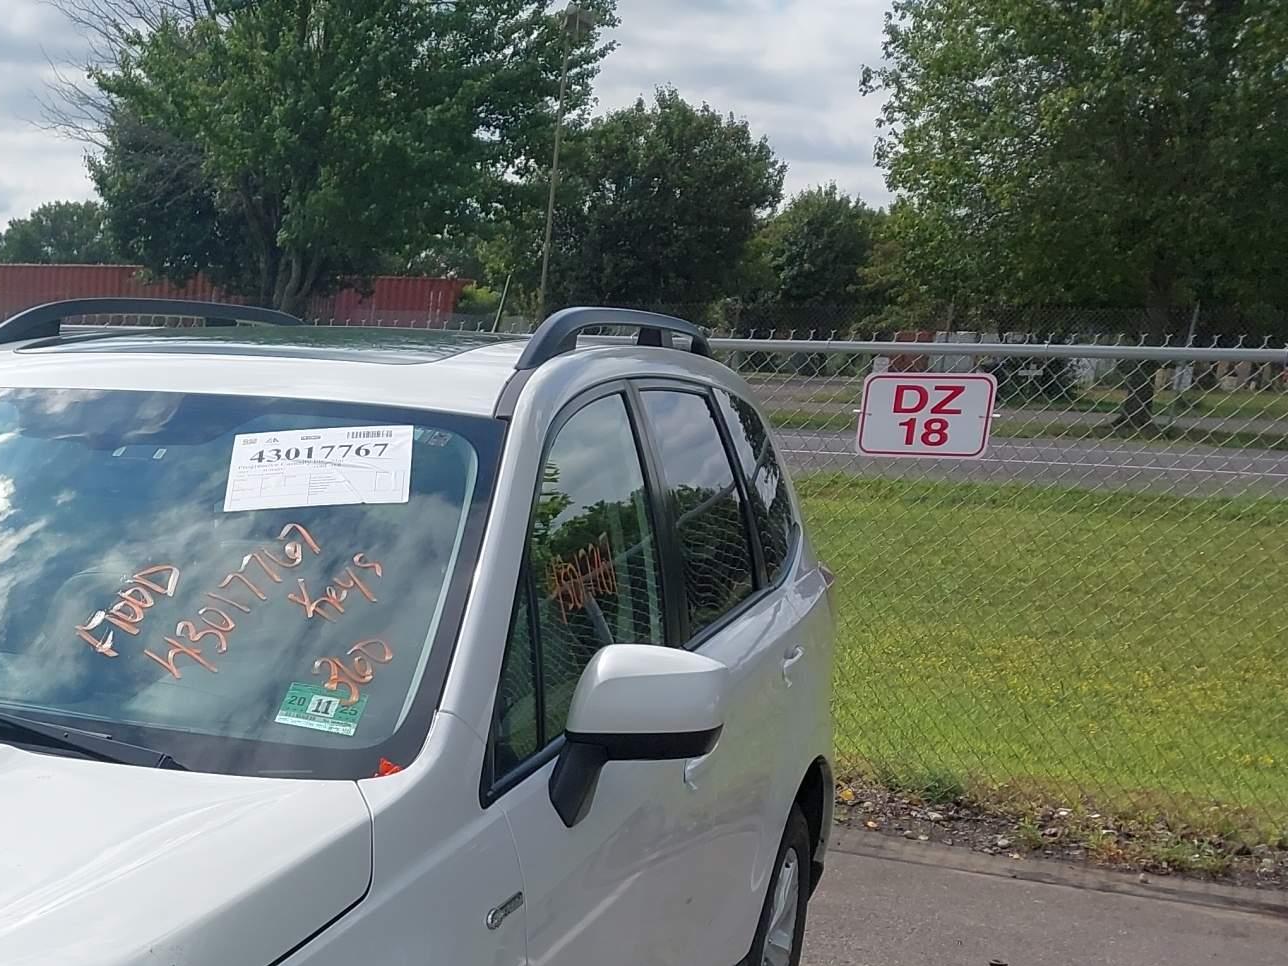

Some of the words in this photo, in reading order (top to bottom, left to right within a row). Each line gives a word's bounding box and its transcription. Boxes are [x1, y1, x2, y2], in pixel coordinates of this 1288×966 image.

[893, 384, 966, 415] DZ
[898, 417, 950, 447] 18
[249, 443, 390, 464] 43017767
[288, 695, 307, 707] 20
[312, 699, 332, 715] 11
